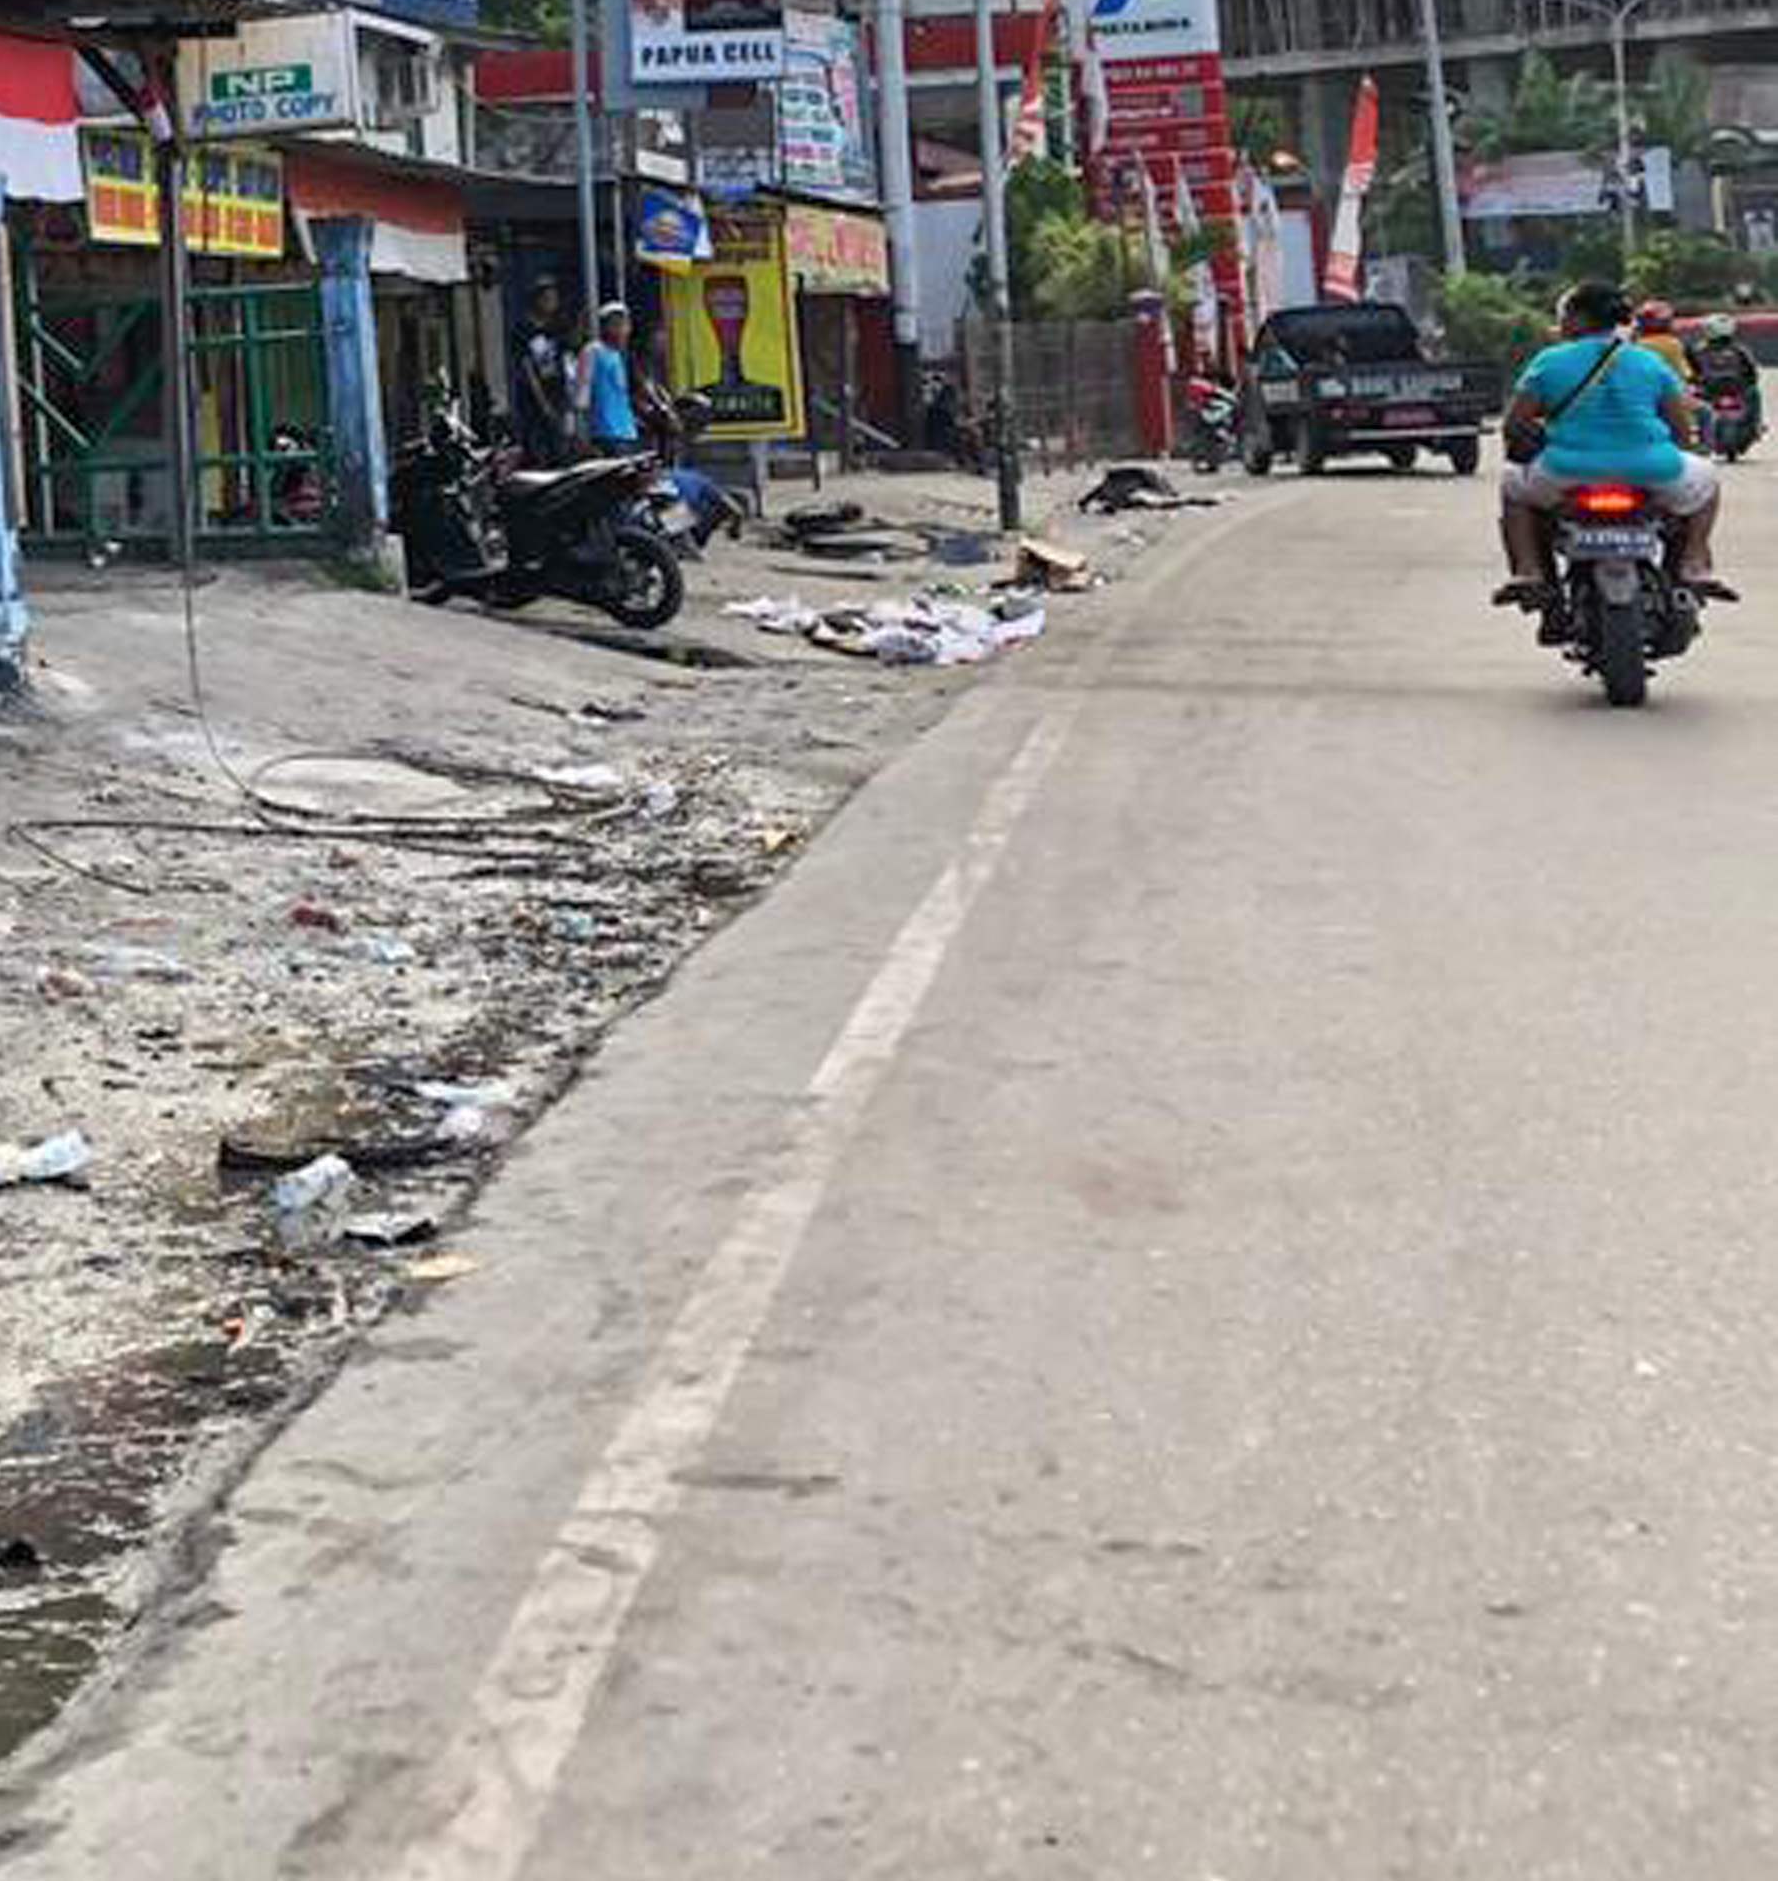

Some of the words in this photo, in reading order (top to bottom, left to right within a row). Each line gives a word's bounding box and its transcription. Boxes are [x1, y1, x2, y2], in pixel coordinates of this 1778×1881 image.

[642, 44, 716, 66] PAPUA
[724, 41, 776, 63] CELL
[226, 70, 293, 96] NP
[192, 96, 267, 129] PHOTO
[276, 93, 338, 119] COPY
